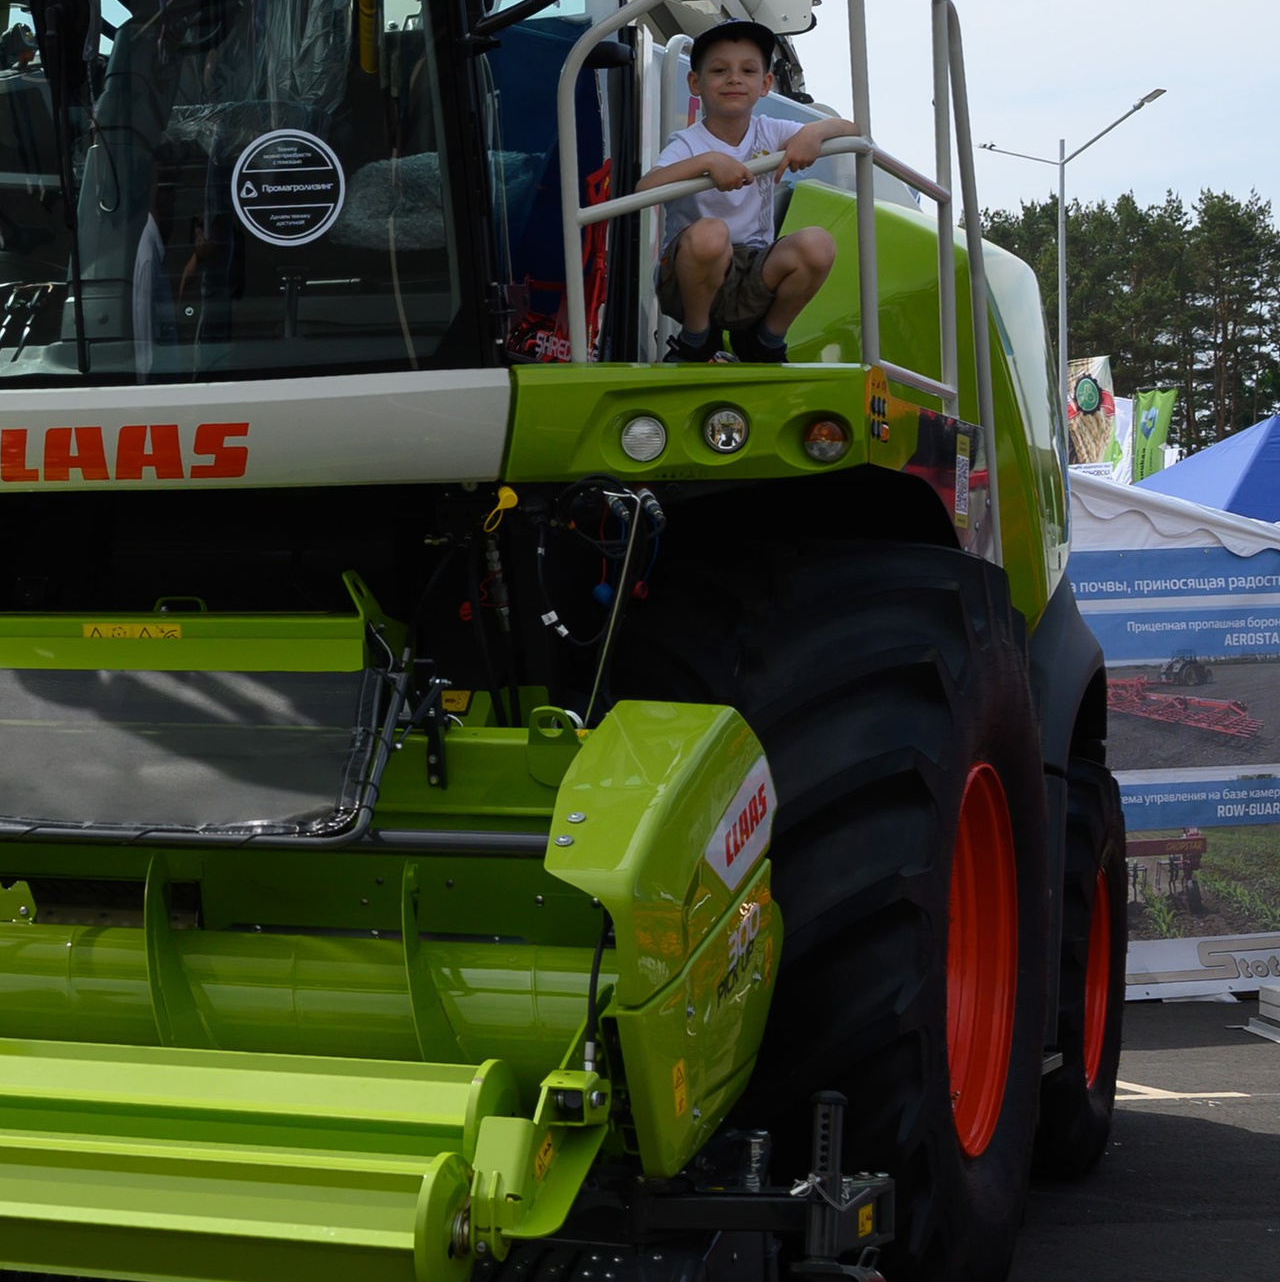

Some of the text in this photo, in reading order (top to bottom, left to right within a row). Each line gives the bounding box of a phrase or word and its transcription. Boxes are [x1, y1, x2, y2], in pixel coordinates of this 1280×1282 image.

[262, 183, 333, 193] Промагролизинг
[1080, 580, 1131, 593] почвы,
[1134, 577, 1225, 594] приносящая
[1127, 621, 1186, 634] Прицепная
[1189, 618, 1246, 631] пропашная
[1145, 792, 1206, 805] управления
[1208, 791, 1220, 800] на
[1223, 788, 1247, 799] базе
[725, 783, 767, 867] CLAAS
